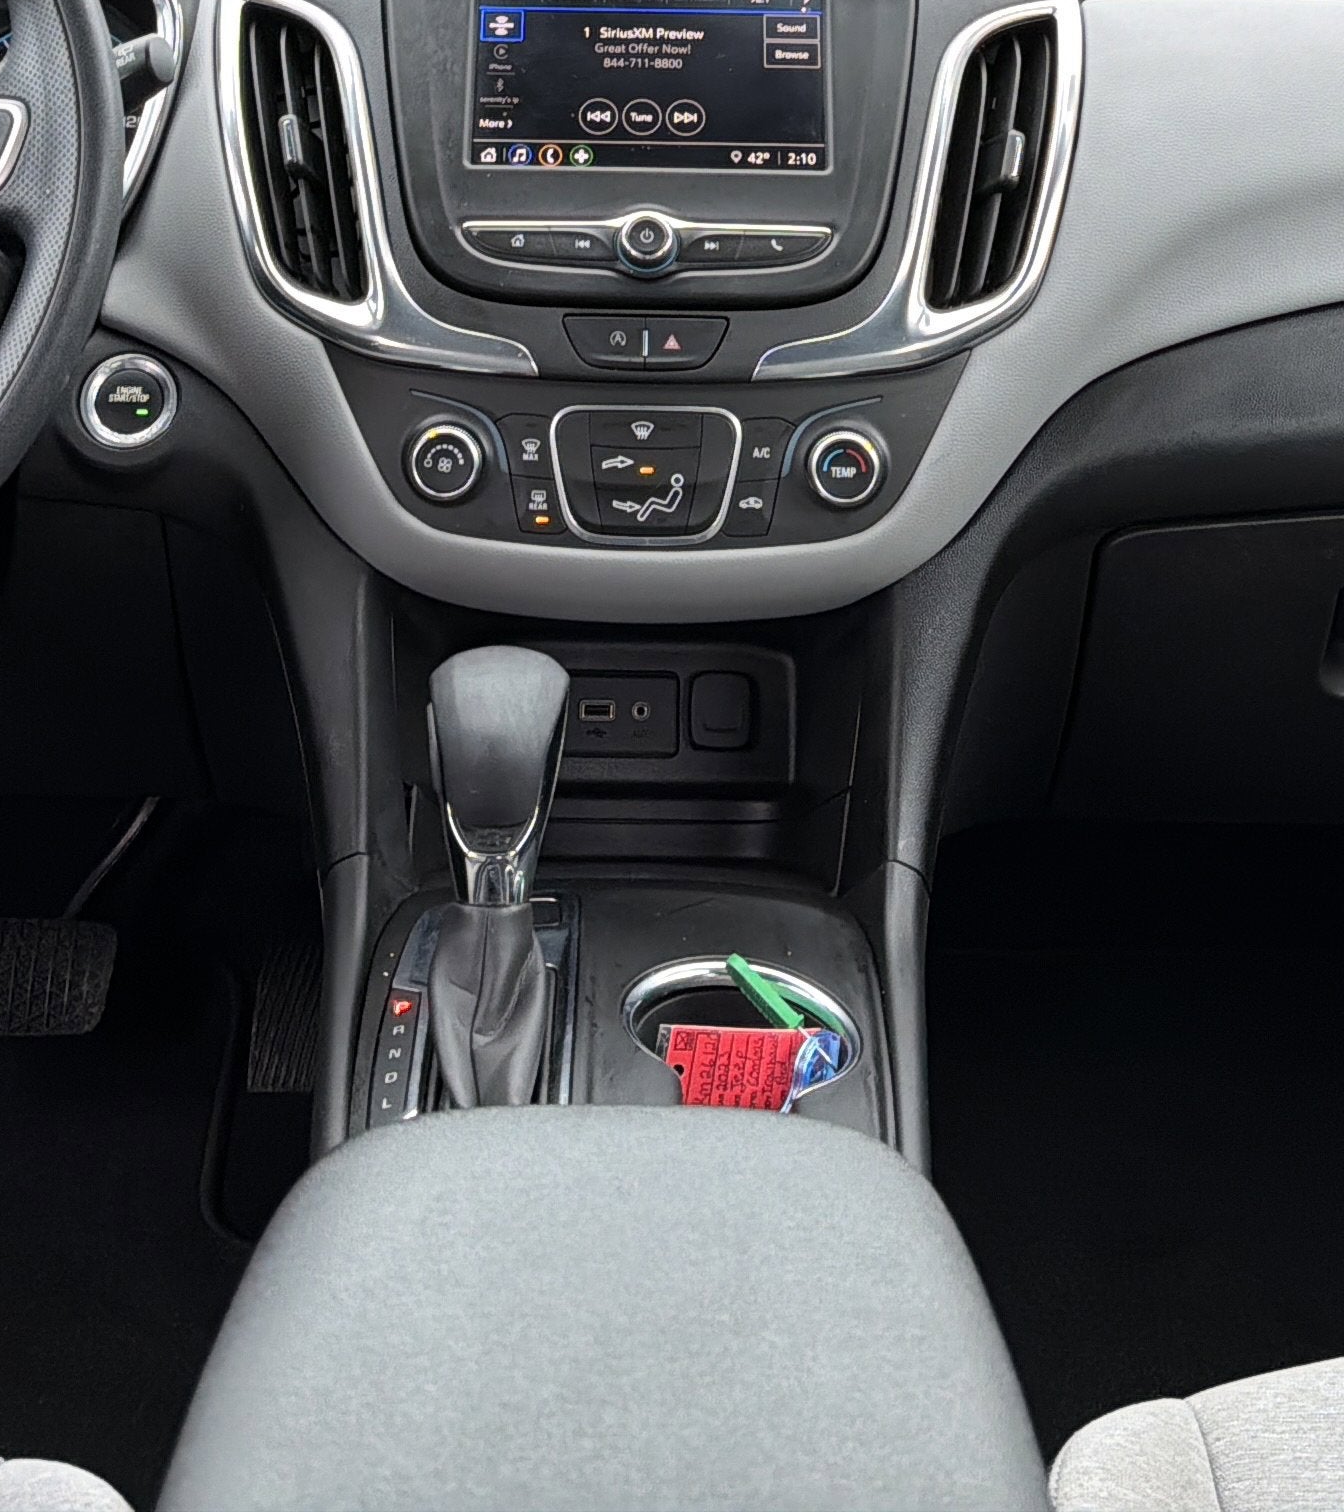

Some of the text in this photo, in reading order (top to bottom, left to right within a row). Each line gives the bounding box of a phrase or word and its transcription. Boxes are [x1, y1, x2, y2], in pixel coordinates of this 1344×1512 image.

[584, 26, 704, 41] 1 SiriusXM Preview
[776, 22, 807, 33] Sound
[594, 42, 692, 55] Great Offer Now!
[774, 49, 809, 60] Browse
[603, 58, 683, 70] 844-711-8800
[629, 111, 653, 123] Tune
[479, 118, 505, 129] More
[747, 150, 771, 165] 42°
[787, 151, 817, 166] 2:10
[116, 386, 144, 395] ENGINE
[108, 393, 150, 403] START/STOP
[522, 452, 539, 461] MAX
[752, 445, 771, 458] A/C
[830, 464, 857, 479] TEMP
[528, 502, 548, 511] REAR
[392, 999, 412, 1017] P
[388, 1048, 402, 1059] N
[384, 1071, 398, 1084] D
[381, 1097, 392, 1110] L
